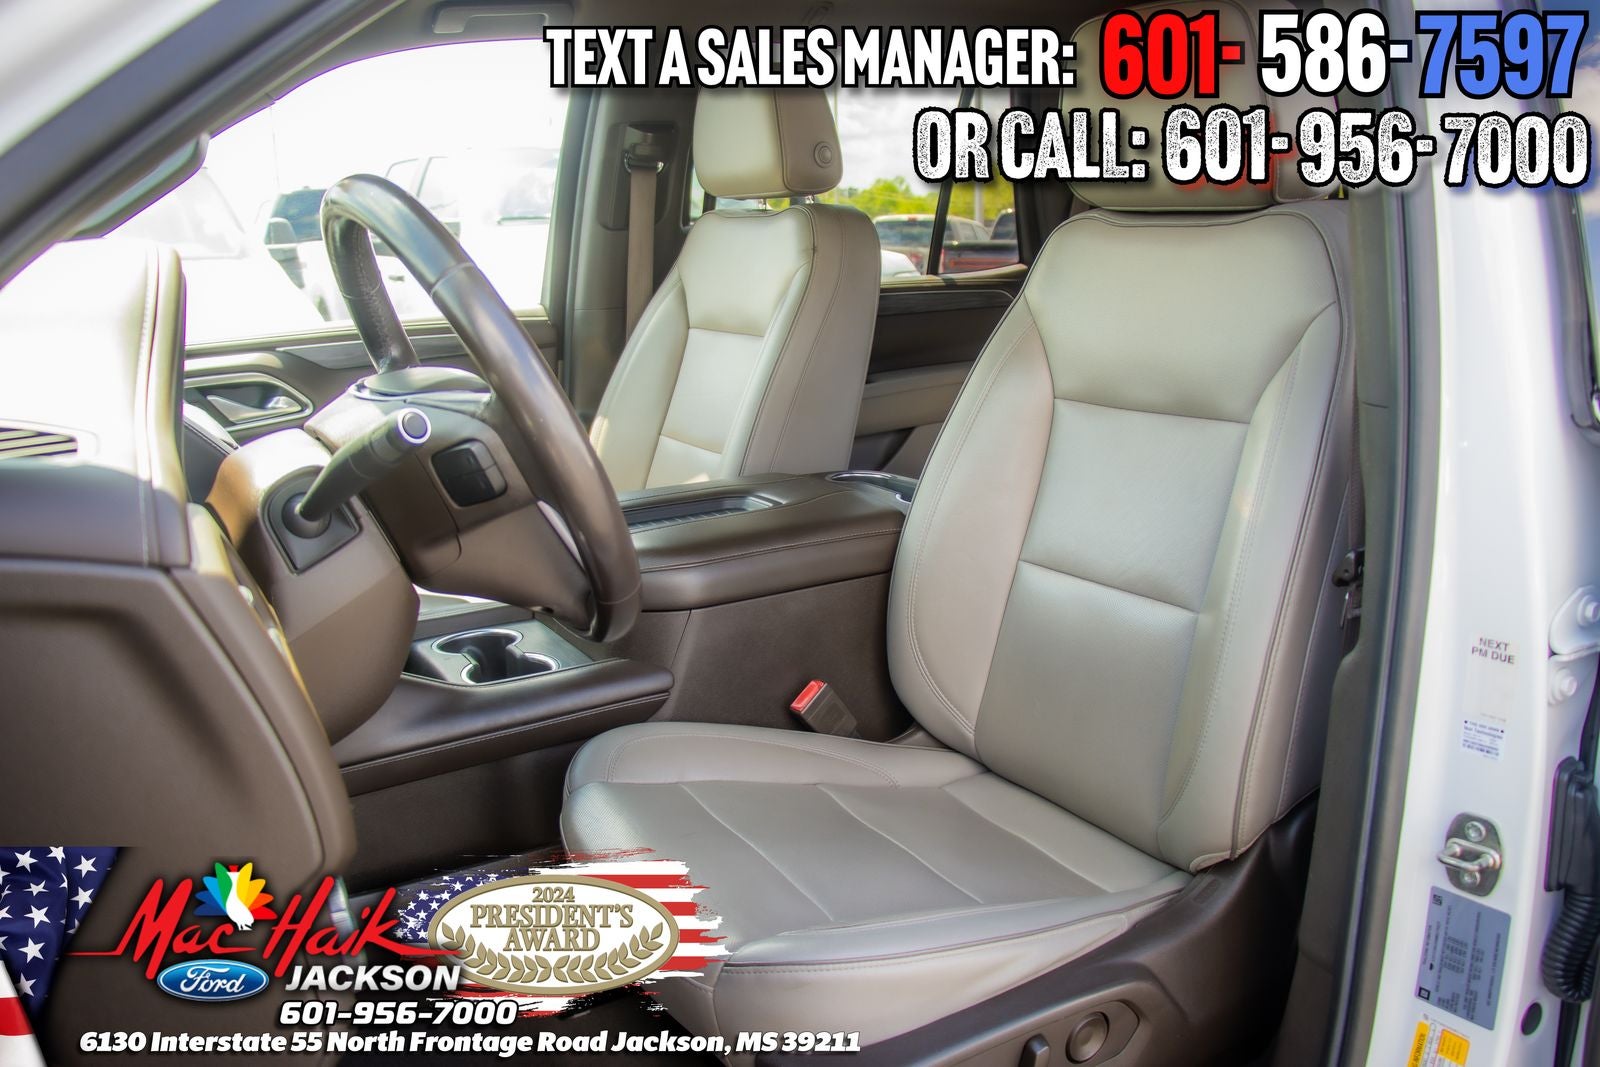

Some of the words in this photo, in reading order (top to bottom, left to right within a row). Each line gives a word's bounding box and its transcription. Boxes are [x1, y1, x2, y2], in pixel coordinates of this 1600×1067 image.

[1478, 637, 1510, 652] NEXT
[1471, 645, 1489, 659] PM
[1490, 650, 1516, 665] DUE
